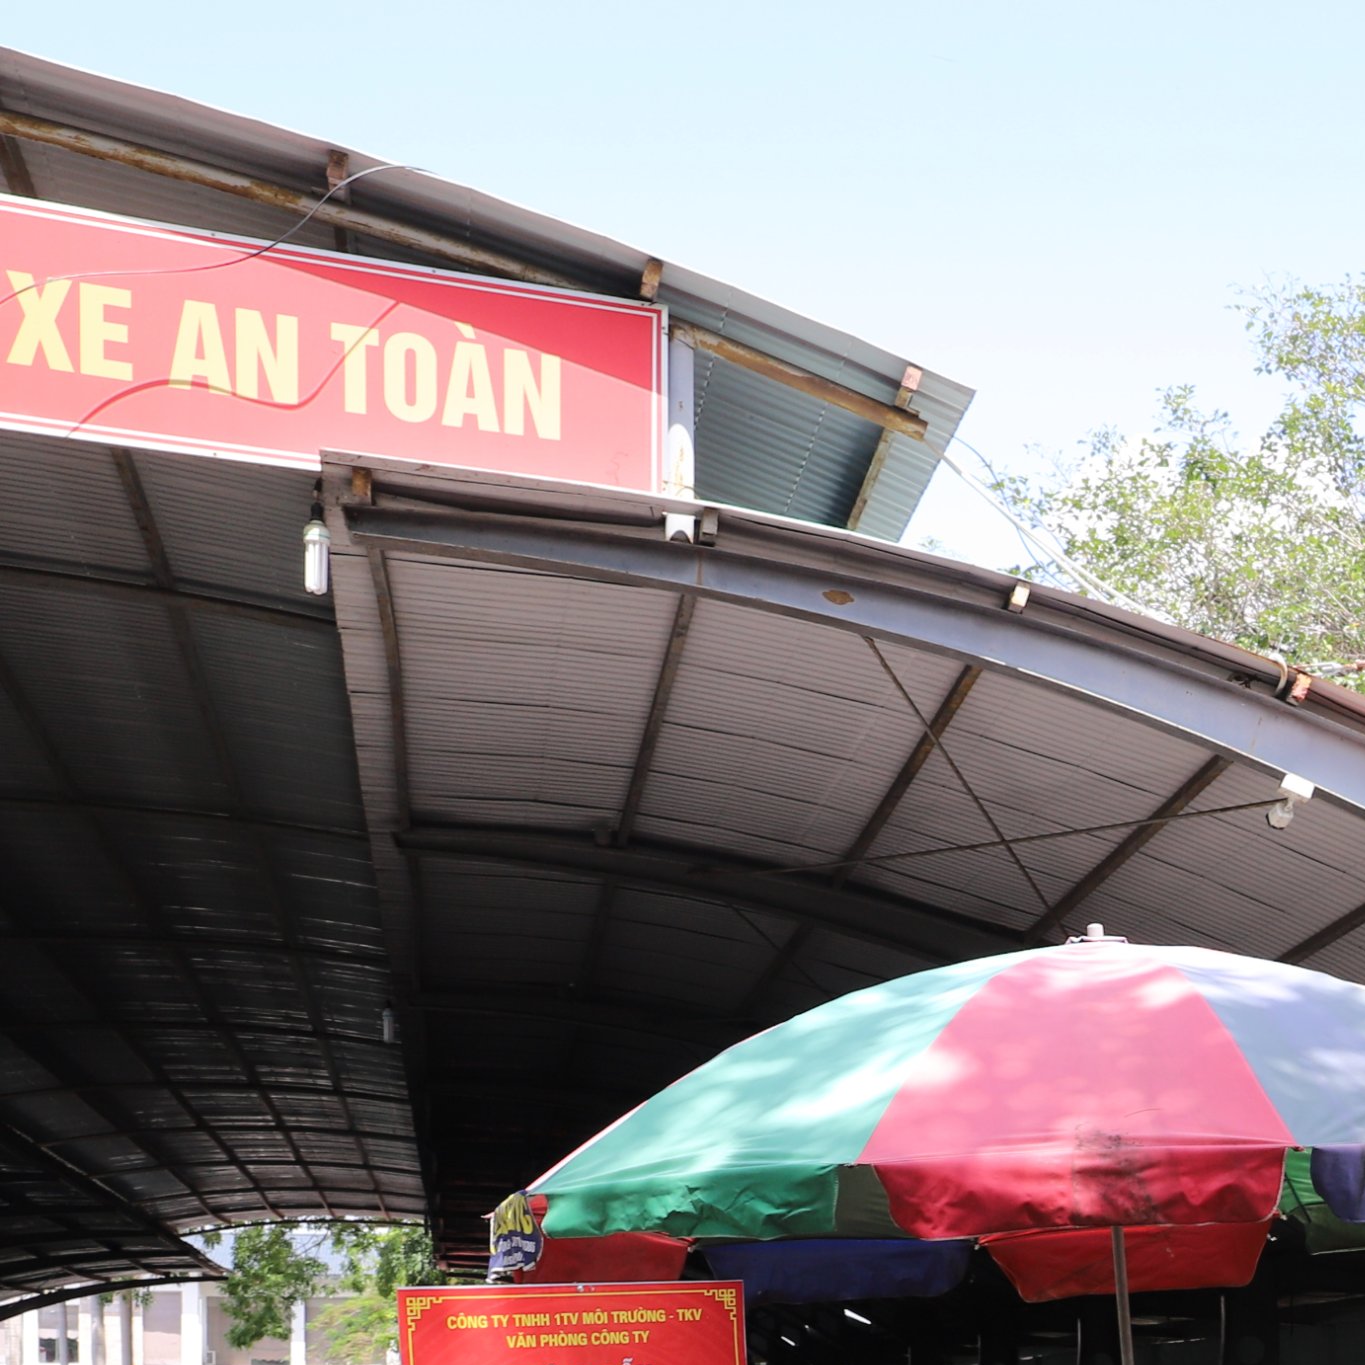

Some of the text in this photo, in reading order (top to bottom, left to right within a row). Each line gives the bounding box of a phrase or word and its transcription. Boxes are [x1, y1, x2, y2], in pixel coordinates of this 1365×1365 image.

[6, 269, 562, 441] XE AN TOÀN
[447, 1312, 488, 1330] CÔNG
[491, 1314, 509, 1328] TY
[512, 1313, 550, 1327] TNHH
[554, 1313, 580, 1326] 1TV
[582, 1309, 608, 1325] MÔI
[610, 1308, 666, 1324] TRƯỜNG
[676, 1308, 702, 1321] TKV
[506, 1328, 650, 1349] VĂN PHÒNG CÔNG TY
